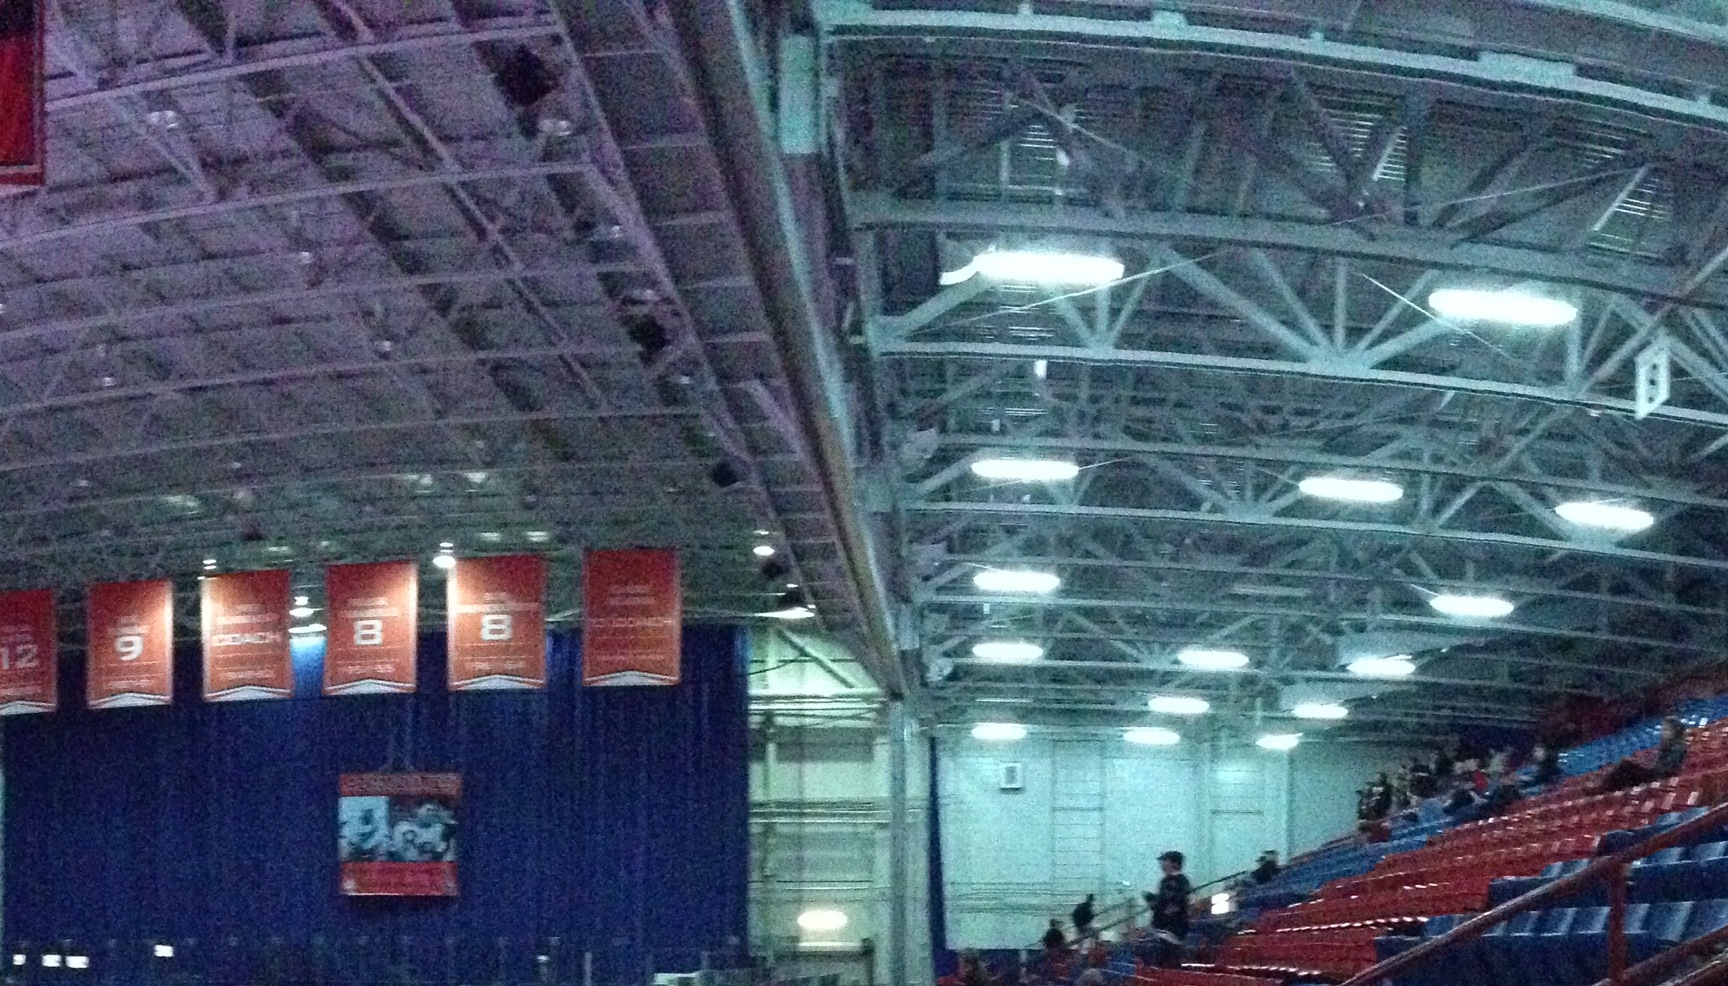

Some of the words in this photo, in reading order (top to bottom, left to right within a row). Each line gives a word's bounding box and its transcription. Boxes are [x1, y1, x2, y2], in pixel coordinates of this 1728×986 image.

[354, 619, 383, 646] 8
[481, 614, 513, 641] 8
[0, 644, 39, 669] 12
[117, 636, 144, 661] 9
